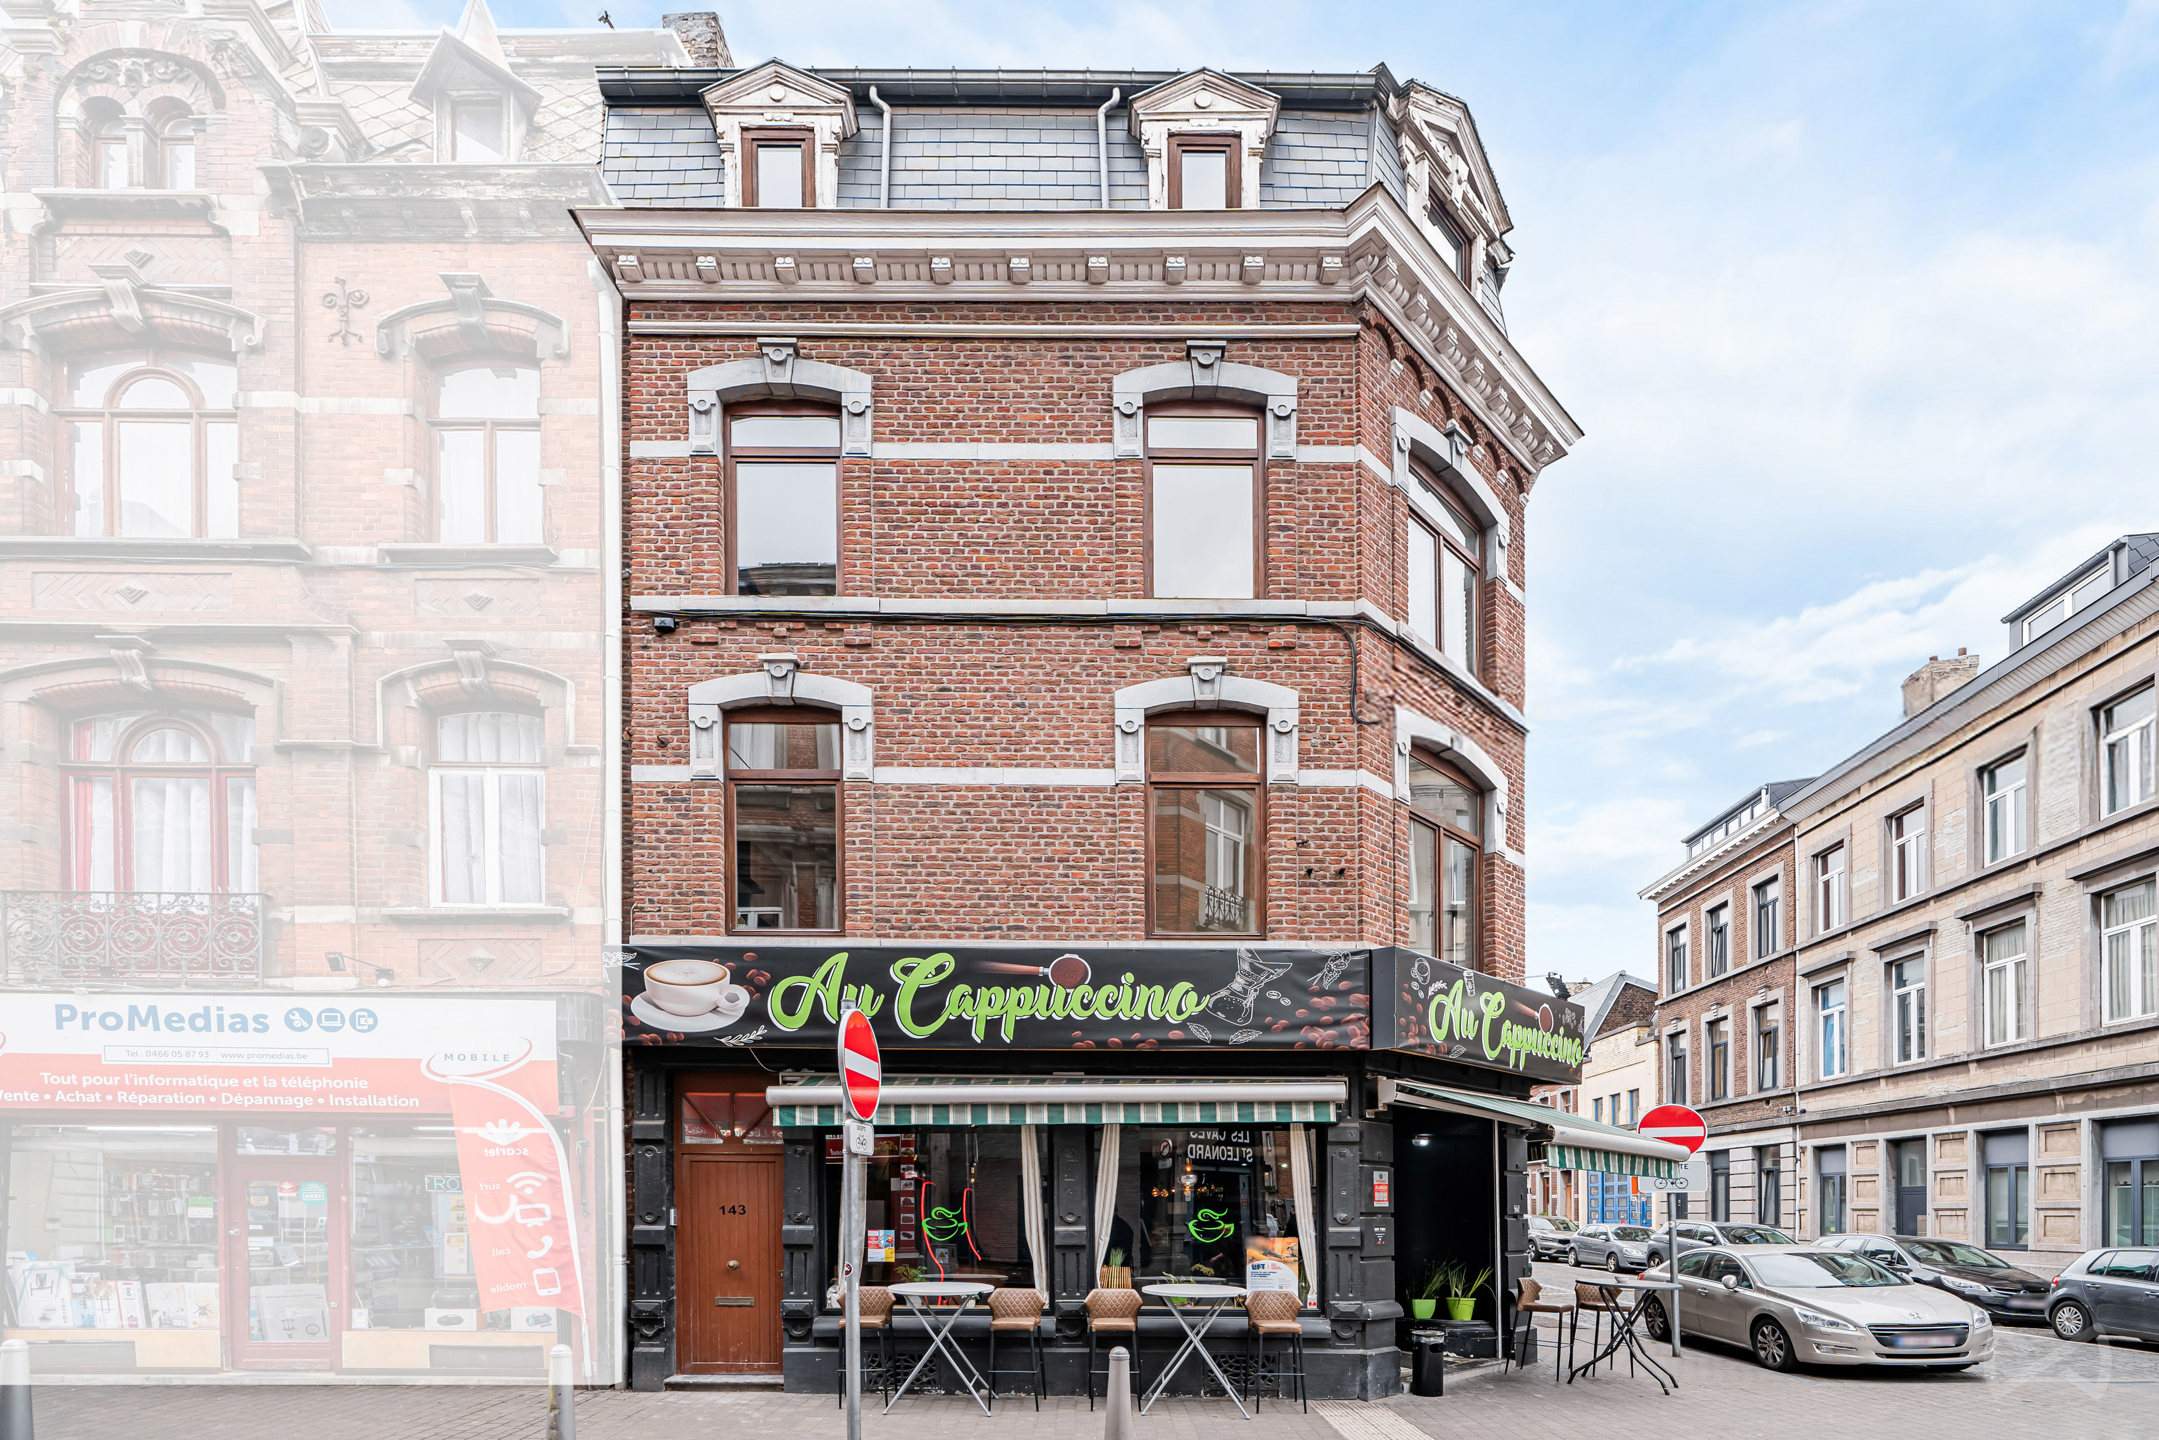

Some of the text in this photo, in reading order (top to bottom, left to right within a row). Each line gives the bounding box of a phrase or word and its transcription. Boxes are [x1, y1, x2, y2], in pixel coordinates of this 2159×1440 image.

[767, 952, 1211, 1044] Au Cappuccino
[54, 1003, 270, 1034] ProMedias
[1428, 978, 1584, 1071] Au Cappuccino
[145, 1050, 169, 1058] 0466
[171, 1050, 183, 1058] 05
[184, 1050, 196, 1058] 87
[197, 1050, 210, 1058] 93
[220, 1051, 308, 1061] www.promedias.be
[444, 1053, 511, 1062] MOBILE
[39, 1072, 368, 1093] Tout pour l'informatique et la téléphonie
[54, 1090, 102, 1103] Achat
[117, 1091, 205, 1106] Réparation
[221, 1092, 314, 1109] Dépannage
[329, 1093, 420, 1107] Installation
[719, 1204, 747, 1216] 143
